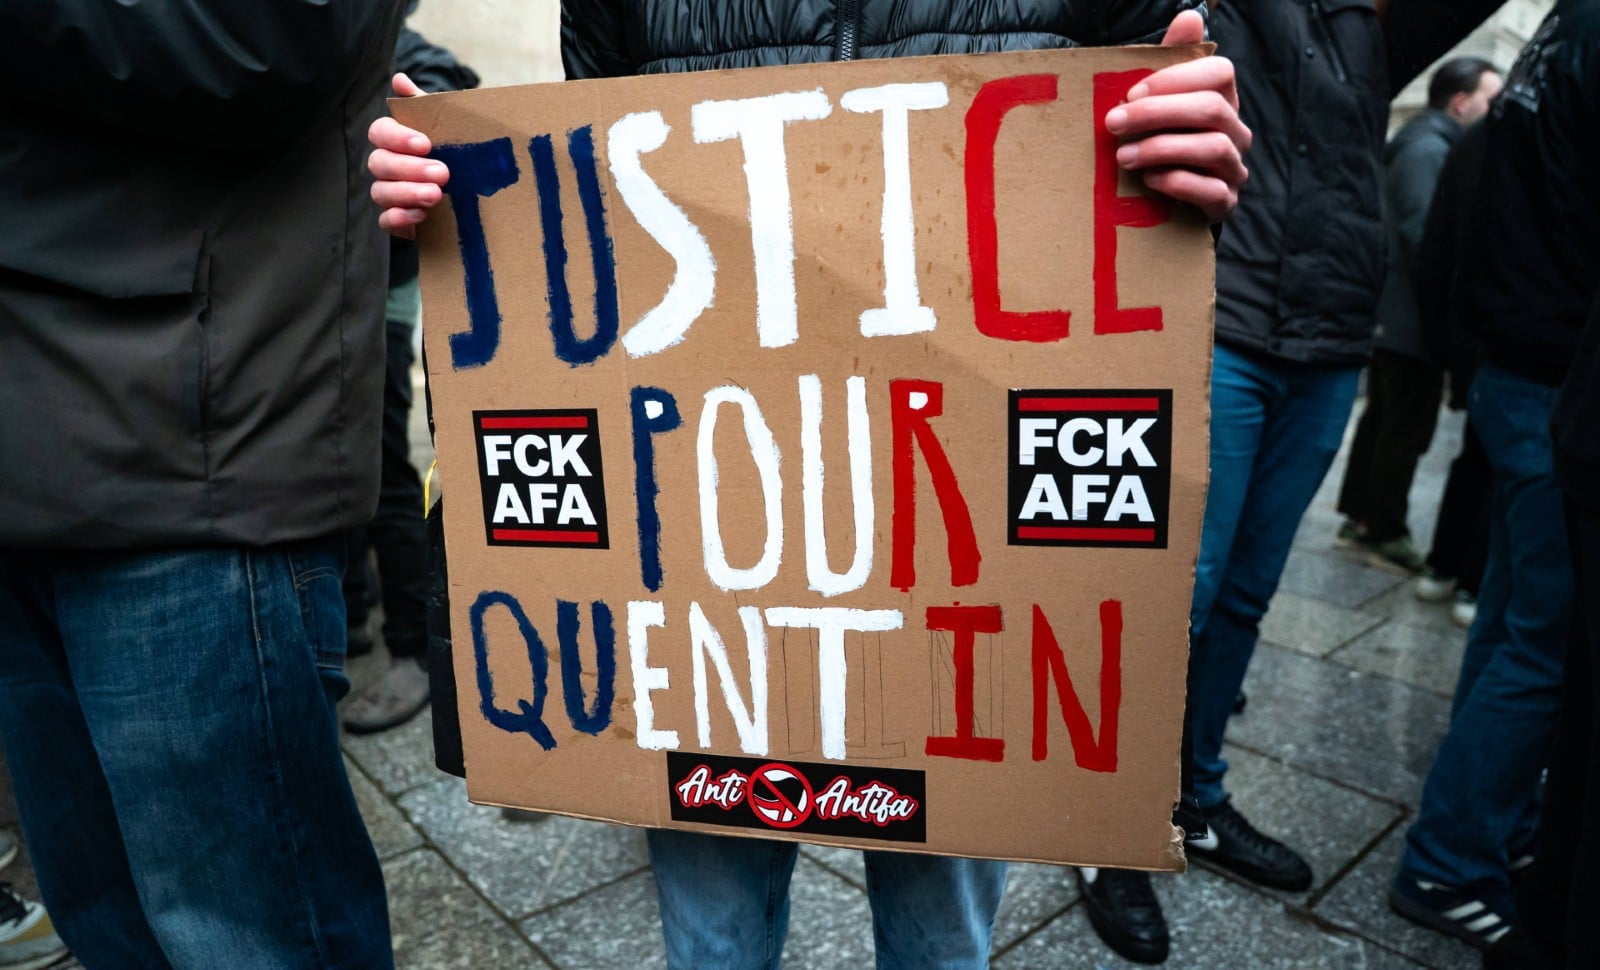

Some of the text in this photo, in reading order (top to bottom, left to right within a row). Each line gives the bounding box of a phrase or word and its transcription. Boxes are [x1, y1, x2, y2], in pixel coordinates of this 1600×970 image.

[429, 68, 1173, 371] JUSTICE
[483, 434, 593, 477] FCK
[1019, 417, 1158, 467] FCK
[492, 483, 598, 525] AFA
[632, 375, 981, 596] POUR
[1018, 474, 1156, 522] AFA
[470, 590, 1123, 773] QUENTIN
[677, 766, 916, 824] Anti Antifa
